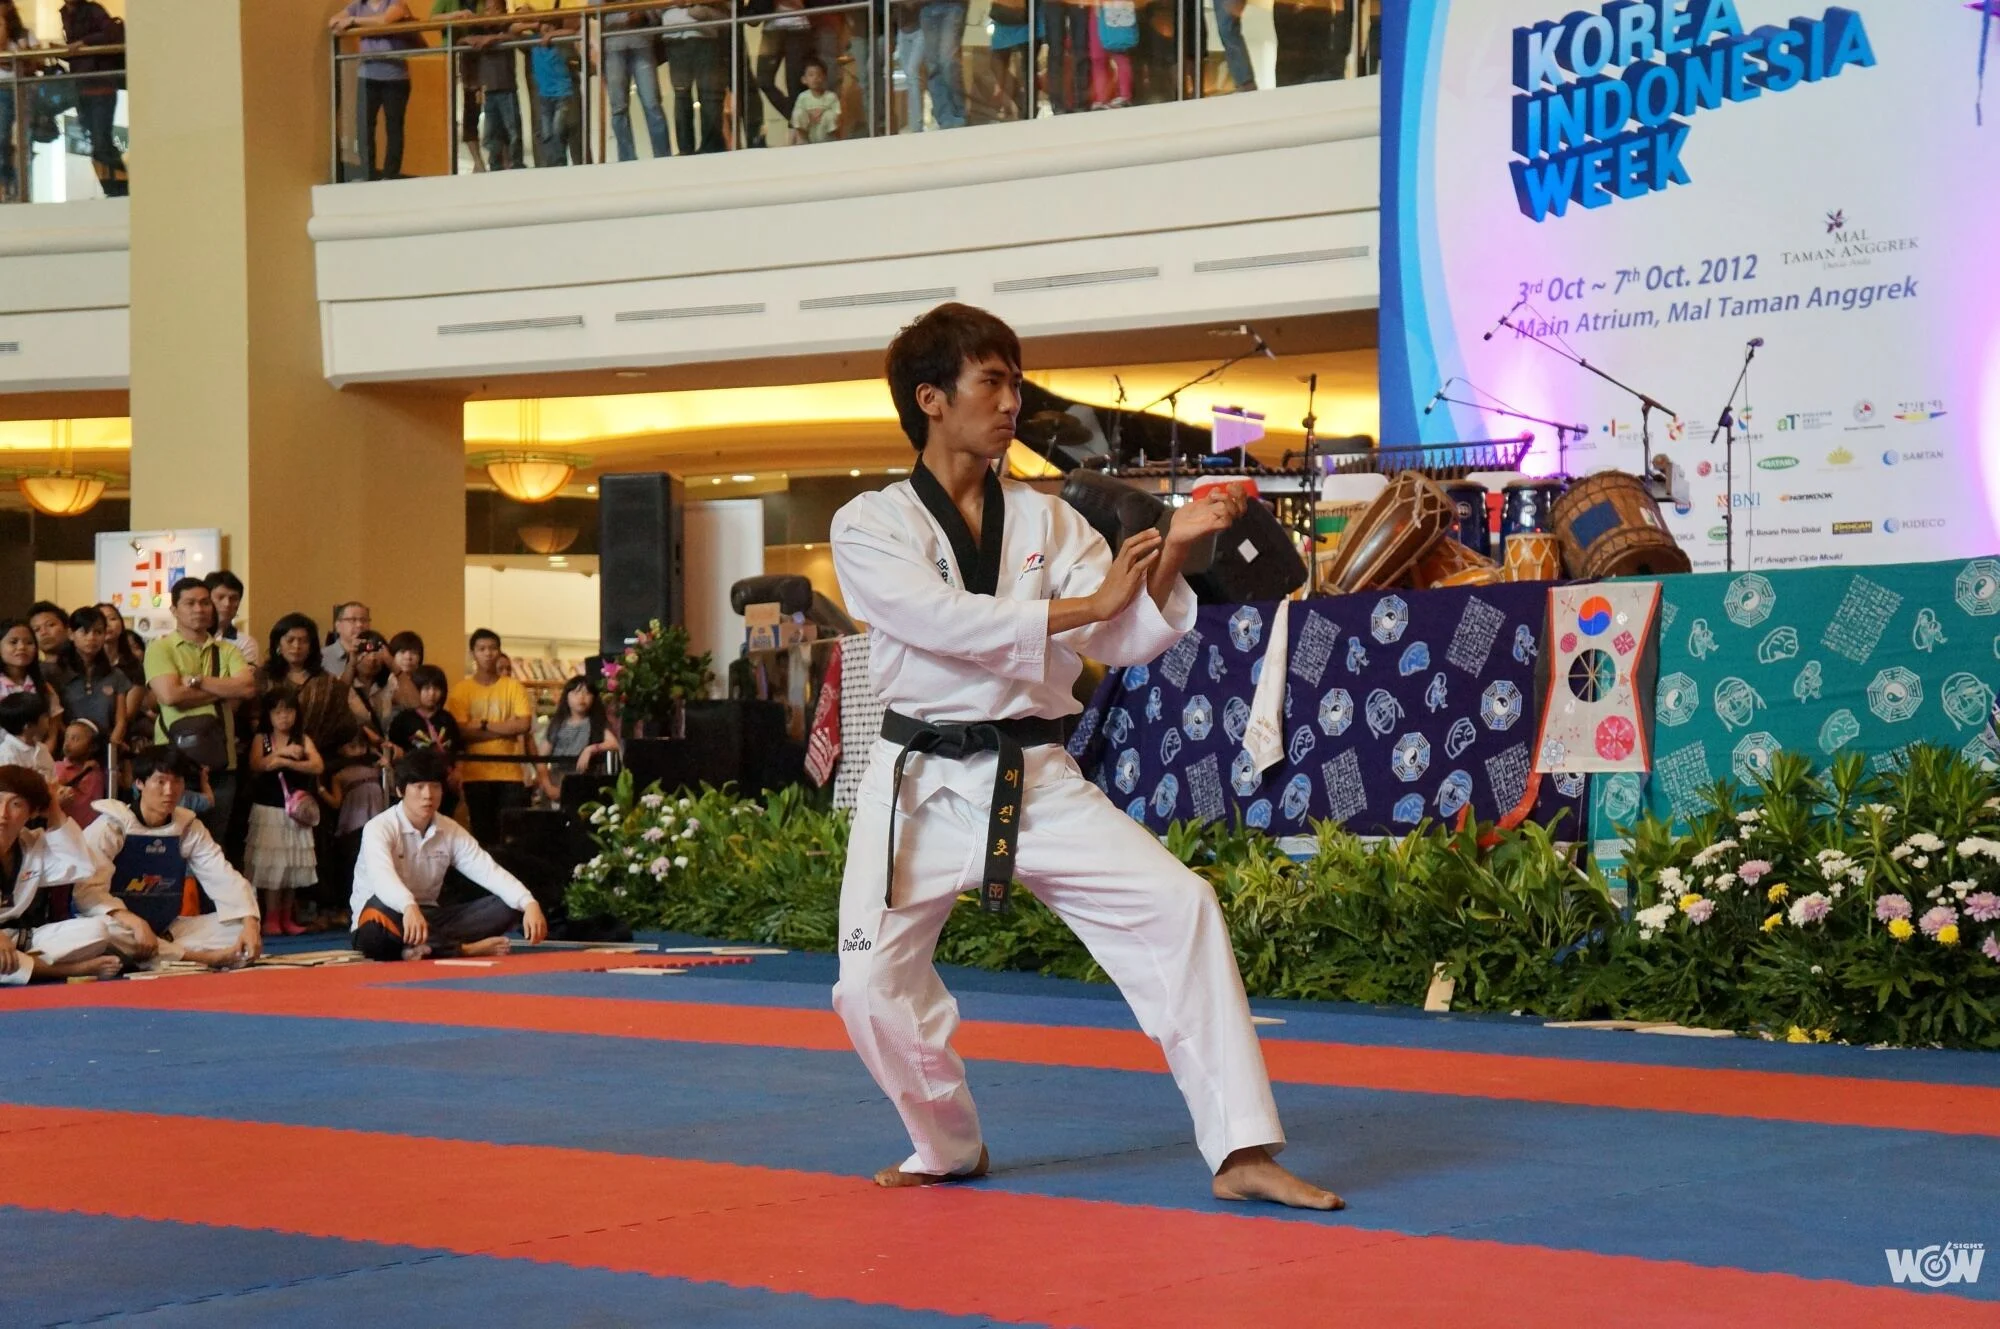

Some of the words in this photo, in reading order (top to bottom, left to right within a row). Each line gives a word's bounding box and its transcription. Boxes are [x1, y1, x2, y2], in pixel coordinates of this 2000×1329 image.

[1512, 0, 1744, 94] KOREA
[1512, 5, 1878, 160] INDONESIA
[1508, 119, 1692, 223] WEEK
[1835, 229, 1869, 243] MAL
[1781, 249, 1836, 266] TAMAN
[1840, 237, 1919, 258] ANGGREK
[1518, 279, 1543, 303] 3rd
[1548, 277, 1585, 302] Oct
[1614, 267, 1640, 295] 7th
[1646, 264, 1690, 291] Oct.
[1698, 254, 1758, 285] 2012
[1515, 316, 1569, 340] Main
[1576, 309, 1660, 334] Atrium,
[1668, 298, 1711, 324] Mal
[1718, 293, 1799, 317] Taman
[1806, 275, 1919, 311] Anggrek
[1902, 450, 1944, 461] SAMTAN
[1732, 492, 1761, 508] BNI
[1902, 518, 1947, 529] KIDECO
[842, 937, 872, 952] Daedo
